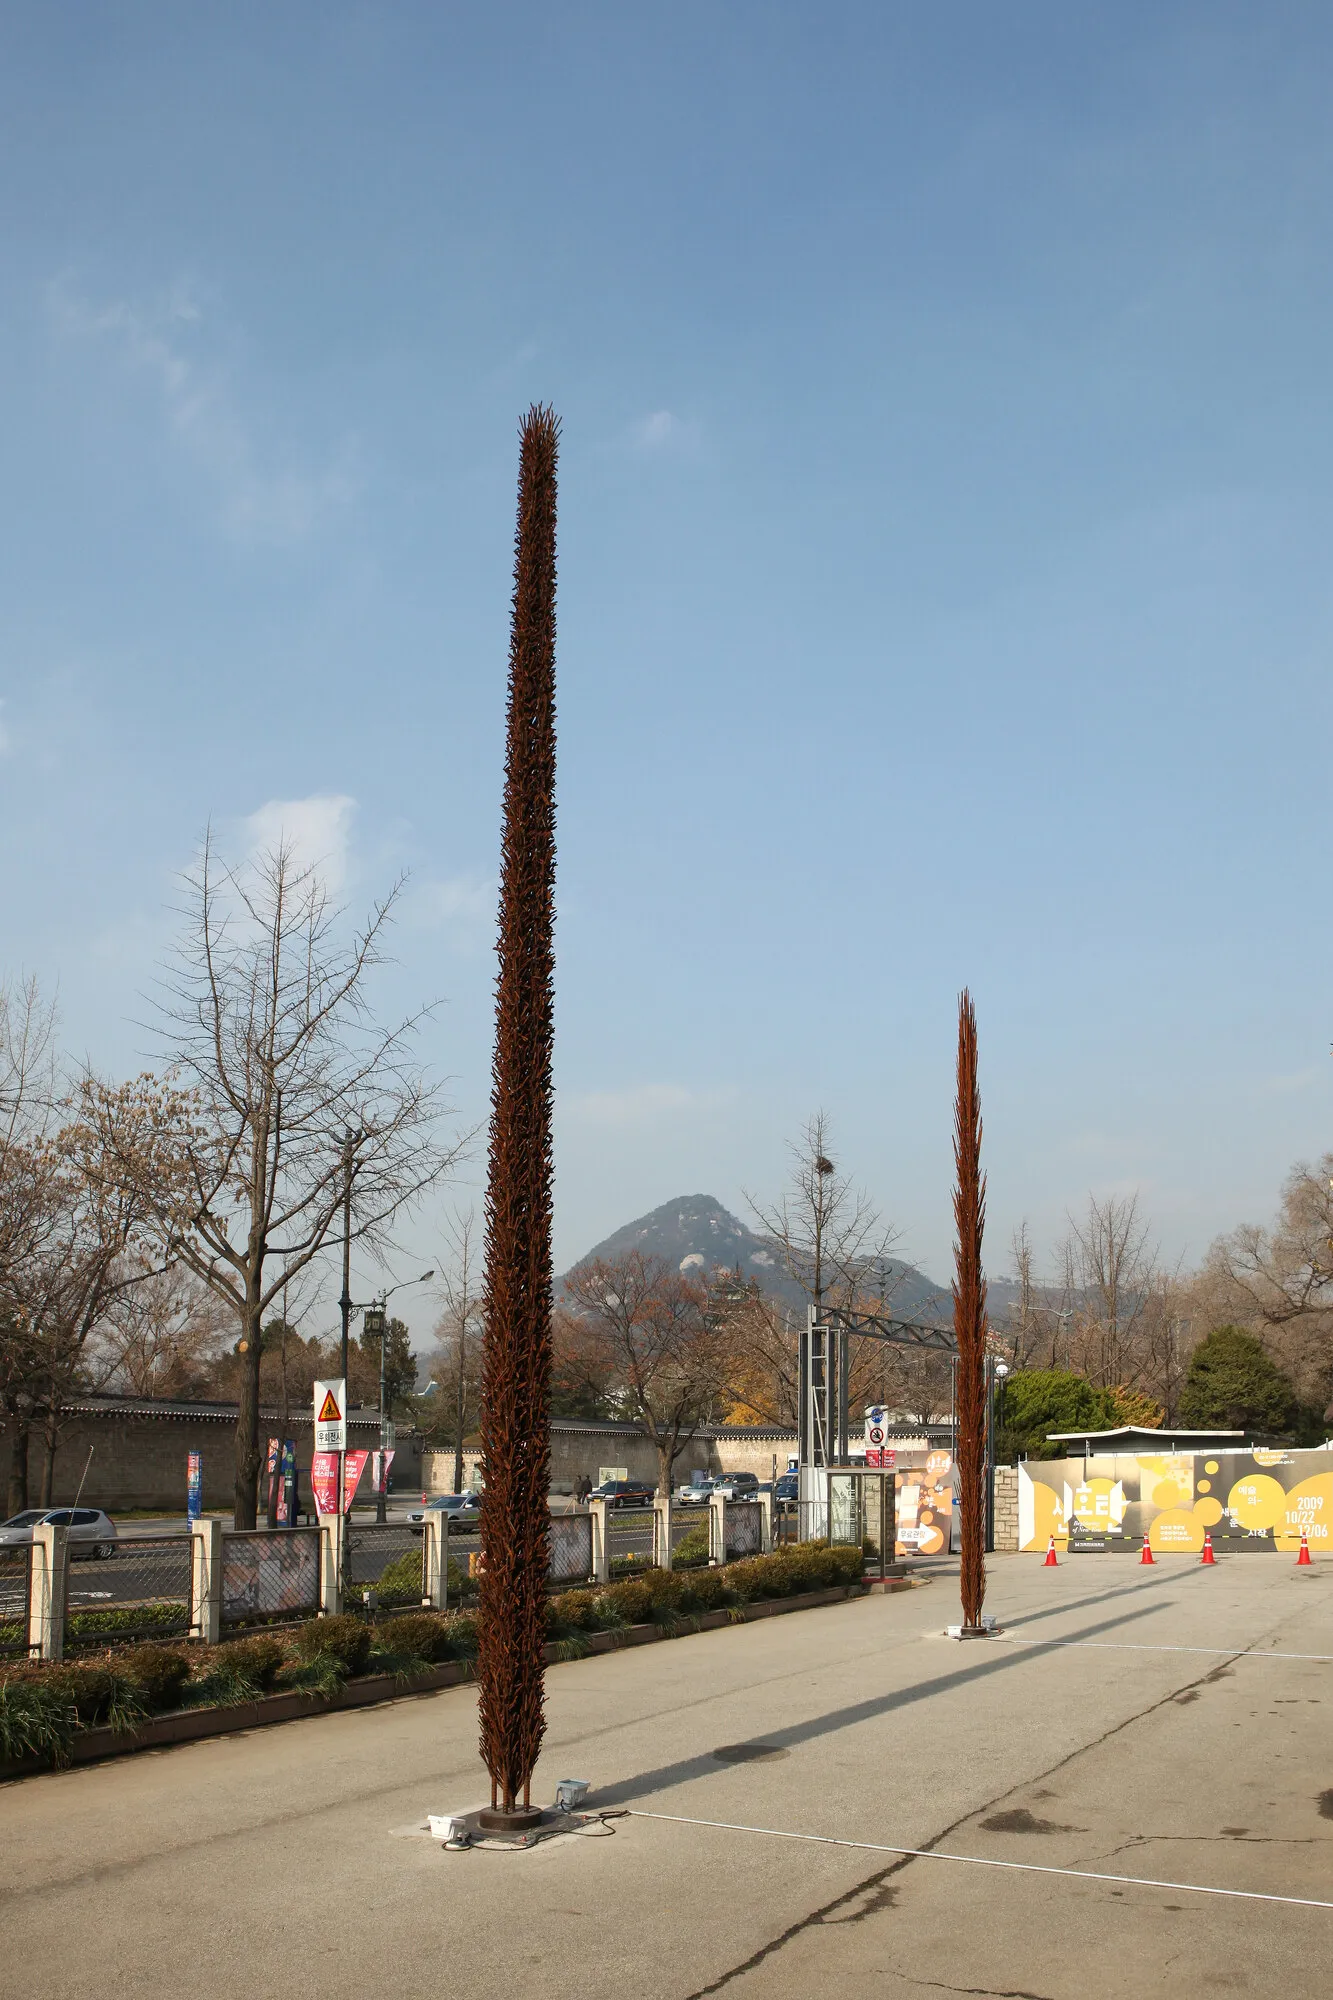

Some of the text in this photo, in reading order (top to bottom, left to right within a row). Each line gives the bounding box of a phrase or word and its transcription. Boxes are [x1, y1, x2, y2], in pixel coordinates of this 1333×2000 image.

[1238, 1485, 1257, 1495] 예술
[1296, 1496, 1324, 1510] 2009
[1285, 1511, 1315, 1524] 10/22
[1297, 1524, 1329, 1538] 12/06
